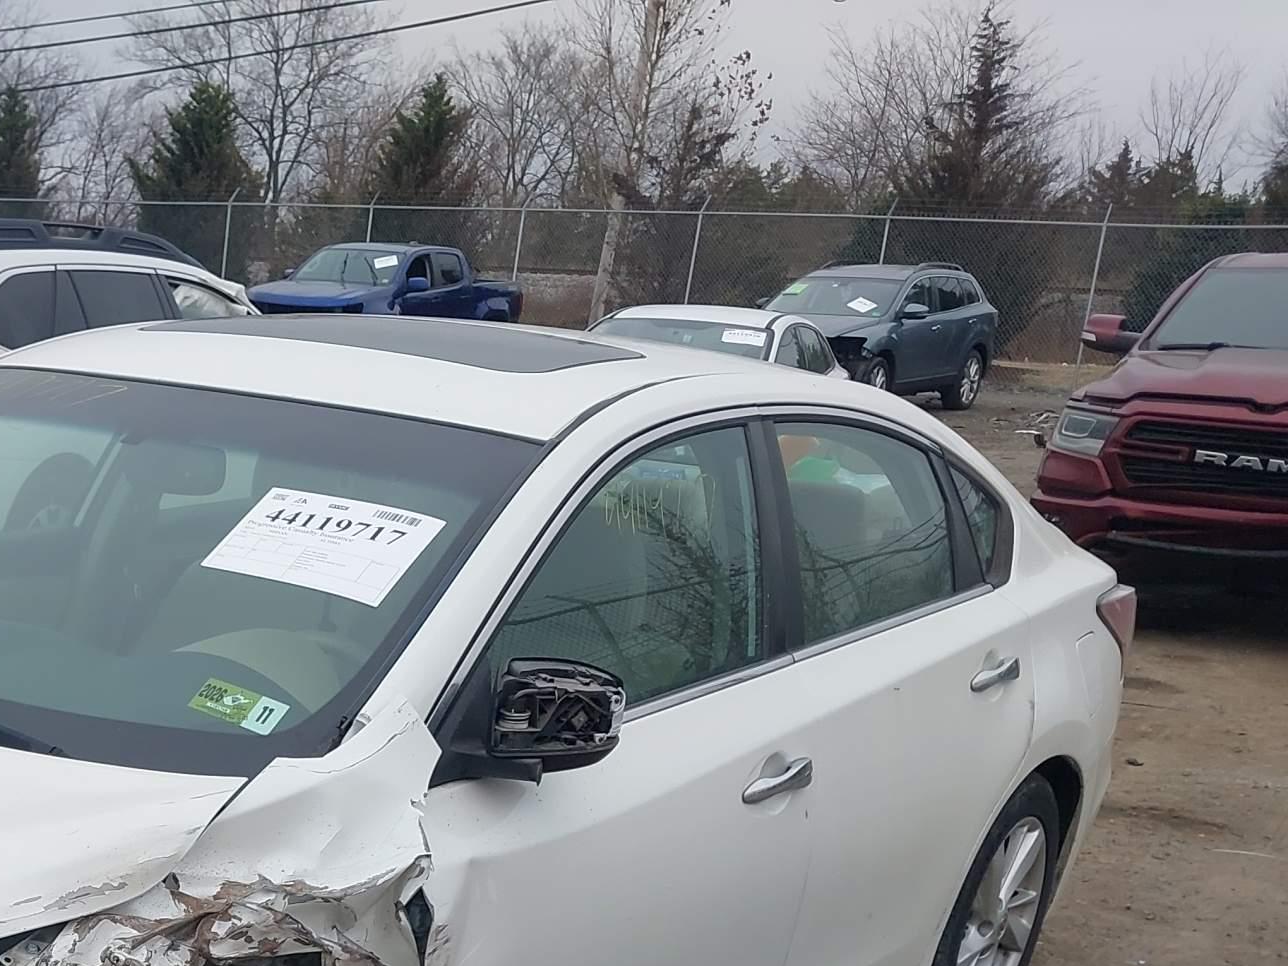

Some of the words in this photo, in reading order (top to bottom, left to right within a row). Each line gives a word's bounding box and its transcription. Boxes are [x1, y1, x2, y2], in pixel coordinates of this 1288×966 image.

[265, 507, 408, 546] 44119717
[198, 683, 228, 704] 2026
[255, 705, 275, 725] 11
